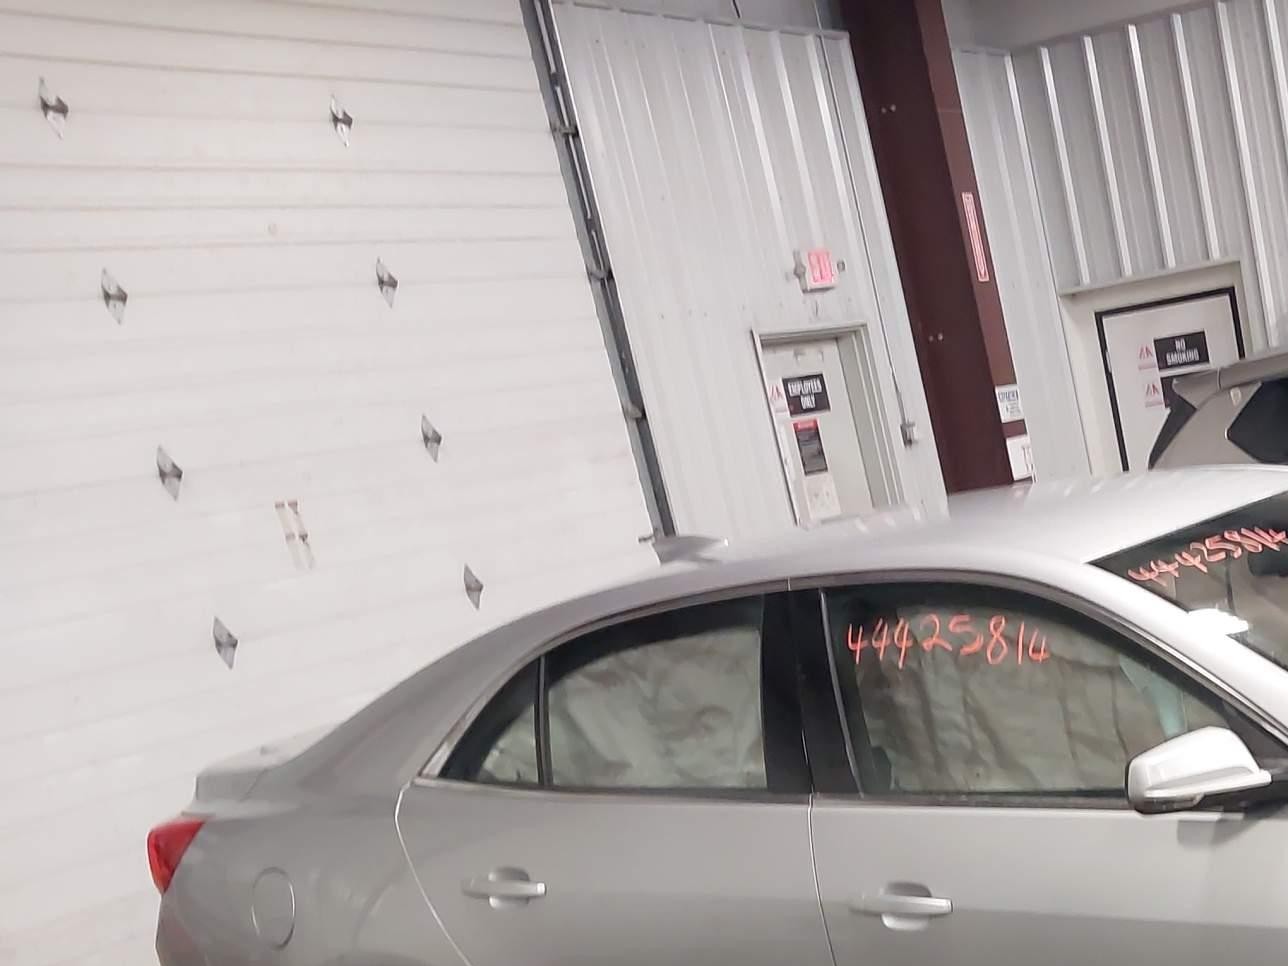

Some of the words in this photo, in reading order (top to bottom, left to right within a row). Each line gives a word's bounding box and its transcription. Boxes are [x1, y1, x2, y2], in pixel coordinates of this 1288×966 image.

[1175, 338, 1186, 352] NO
[1166, 348, 1199, 365] SMOKING
[800, 394, 816, 409] ONLY
[848, 614, 1050, 670] 44425814
